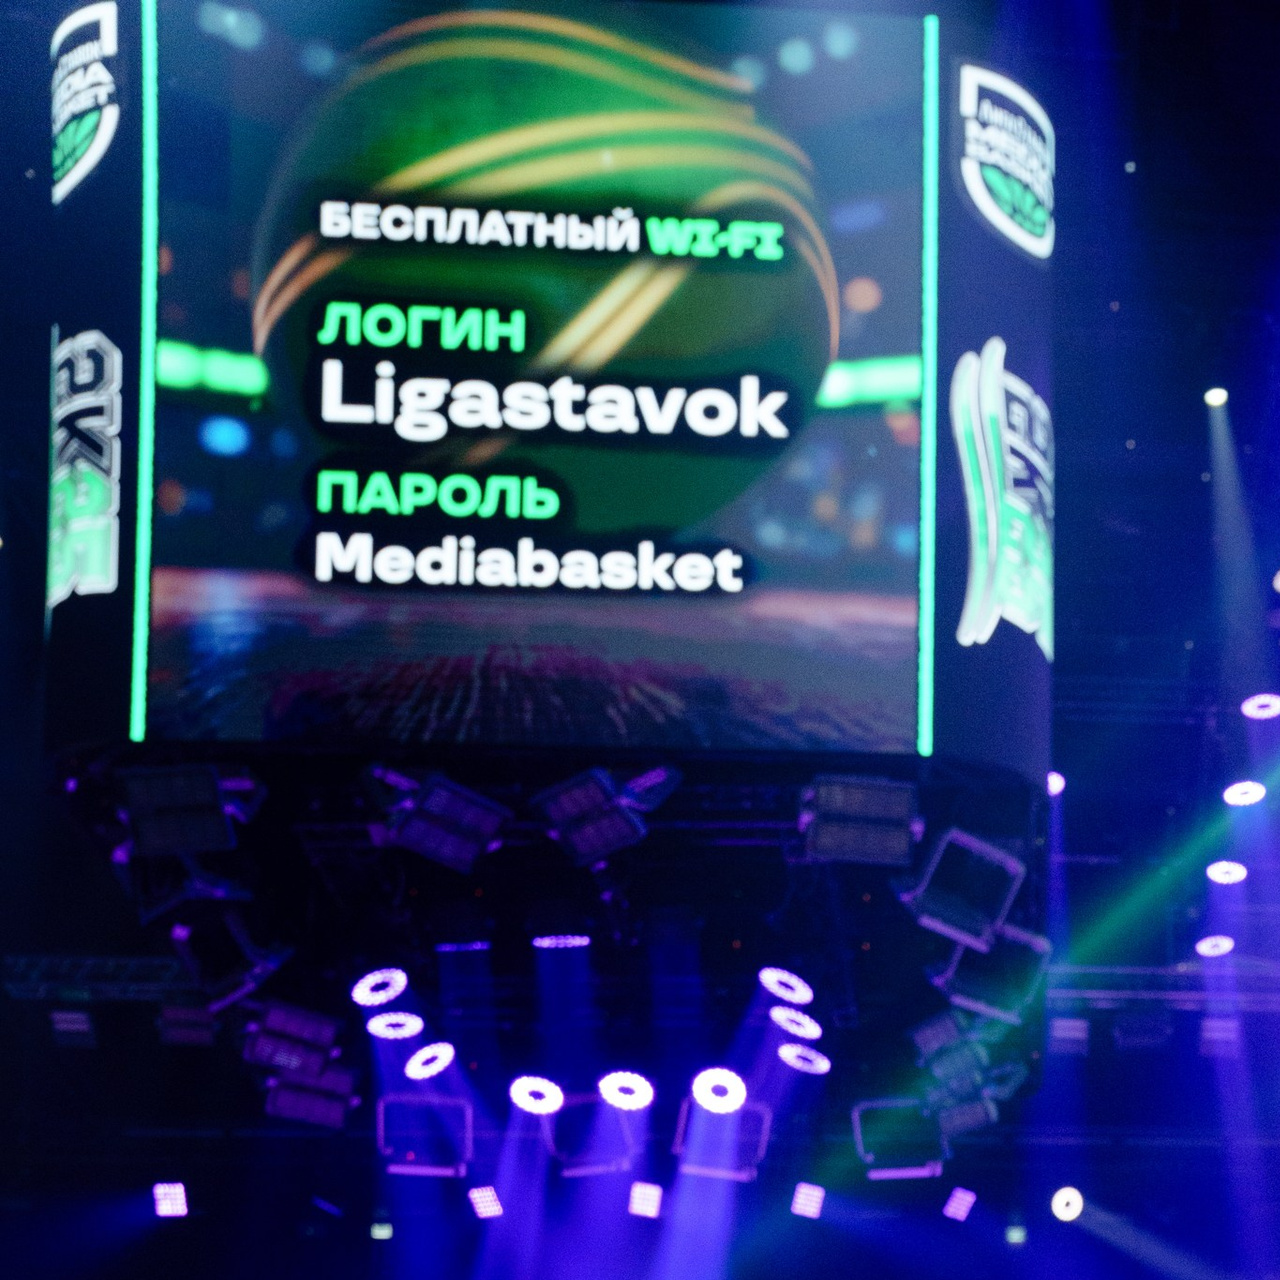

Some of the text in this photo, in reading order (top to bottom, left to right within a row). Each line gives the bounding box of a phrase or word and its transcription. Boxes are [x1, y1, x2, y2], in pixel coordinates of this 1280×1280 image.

[320, 201, 785, 261] БЕСПЛАТНЫЙ WI-FI
[317, 301, 526, 353] ЛОГИН
[321, 359, 789, 443] Ligastavok
[316, 470, 560, 520] ПАРОЛЬ
[315, 532, 743, 593] Mediabasket
